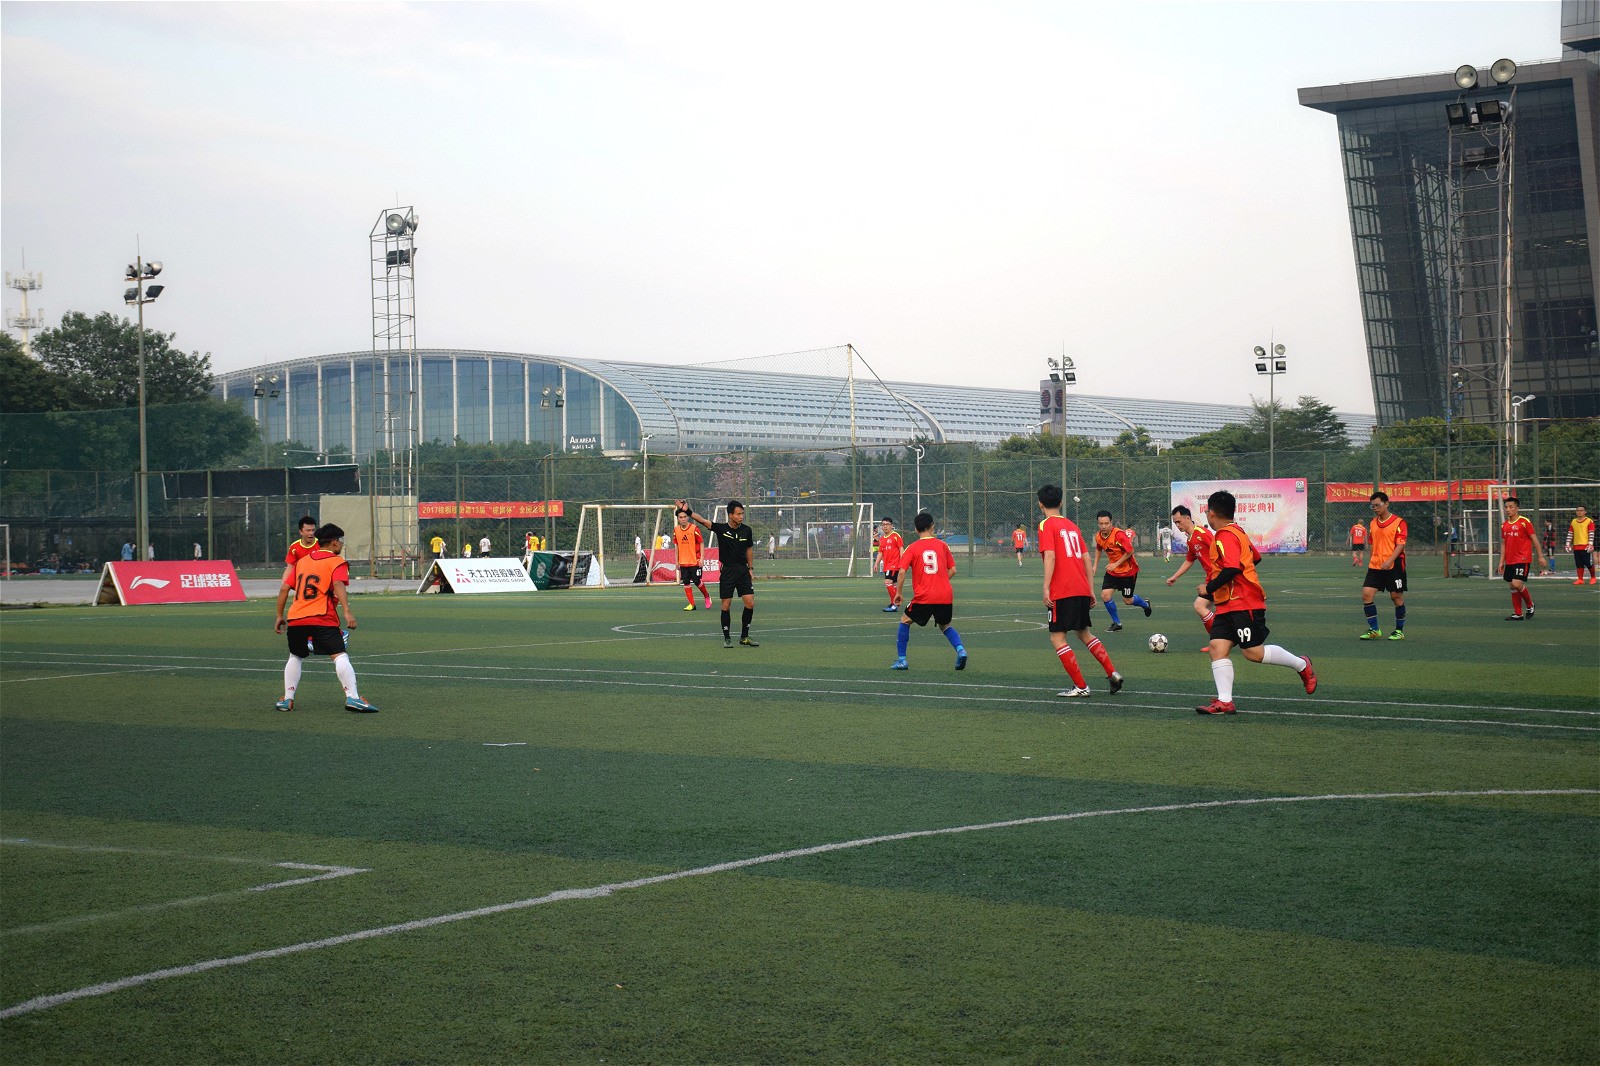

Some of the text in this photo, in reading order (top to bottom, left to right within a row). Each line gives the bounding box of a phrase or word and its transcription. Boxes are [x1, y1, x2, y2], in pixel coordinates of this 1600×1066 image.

[1016, 533, 1023, 541] 11
[1060, 528, 1082, 559] 10
[922, 549, 939, 575] 9
[467, 569, 524, 578] 天士力控股集团
[1515, 567, 1525, 577] 12
[180, 573, 232, 588] 足球装备
[295, 573, 321, 600] 16
[1123, 587, 1132, 596] 10
[1236, 627, 1252, 643] 99
